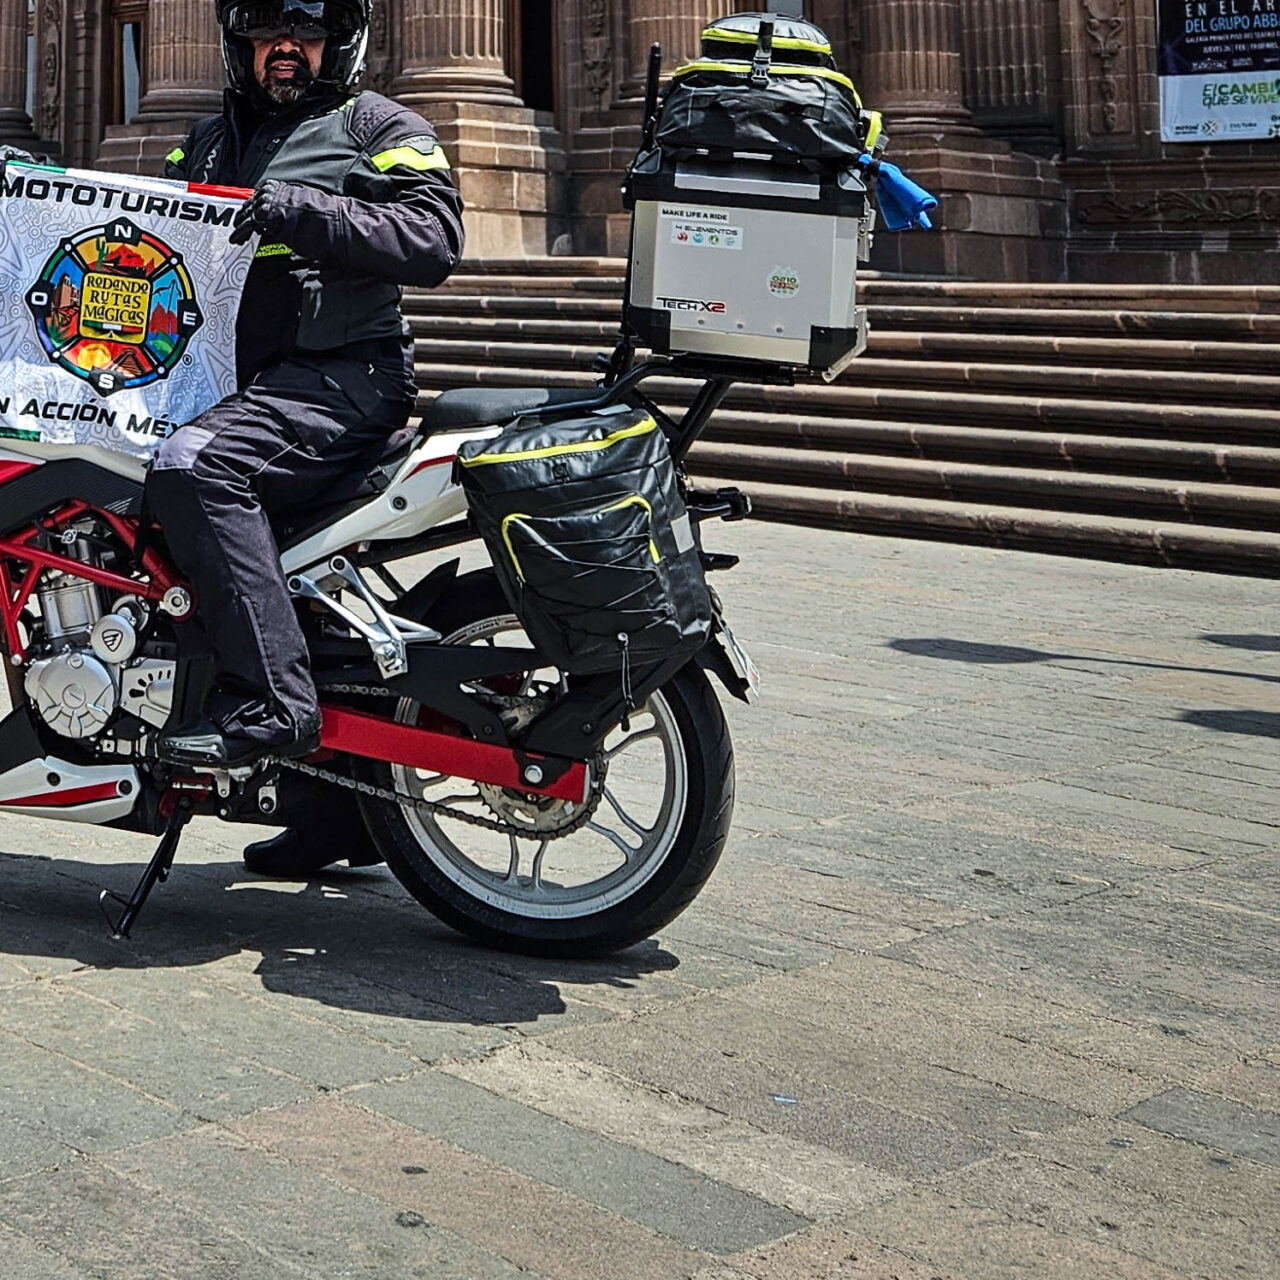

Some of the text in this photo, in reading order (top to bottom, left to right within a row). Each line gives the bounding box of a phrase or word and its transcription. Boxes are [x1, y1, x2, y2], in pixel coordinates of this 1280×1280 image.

[1185, 2, 1207, 18] EN
[1219, 0, 1238, 15] EL
[1185, 19, 1207, 33] DEL
[1210, 15, 1250, 32] GRUPO
[1202, 95, 1229, 109] que
[1232, 94, 1248, 106] se
[662, 209, 684, 217] MAKE
[114, 224, 131, 239] N
[183, 311, 196, 326] E
[98, 374, 115, 389] S
[19, 398, 118, 428] ACCIÓN
